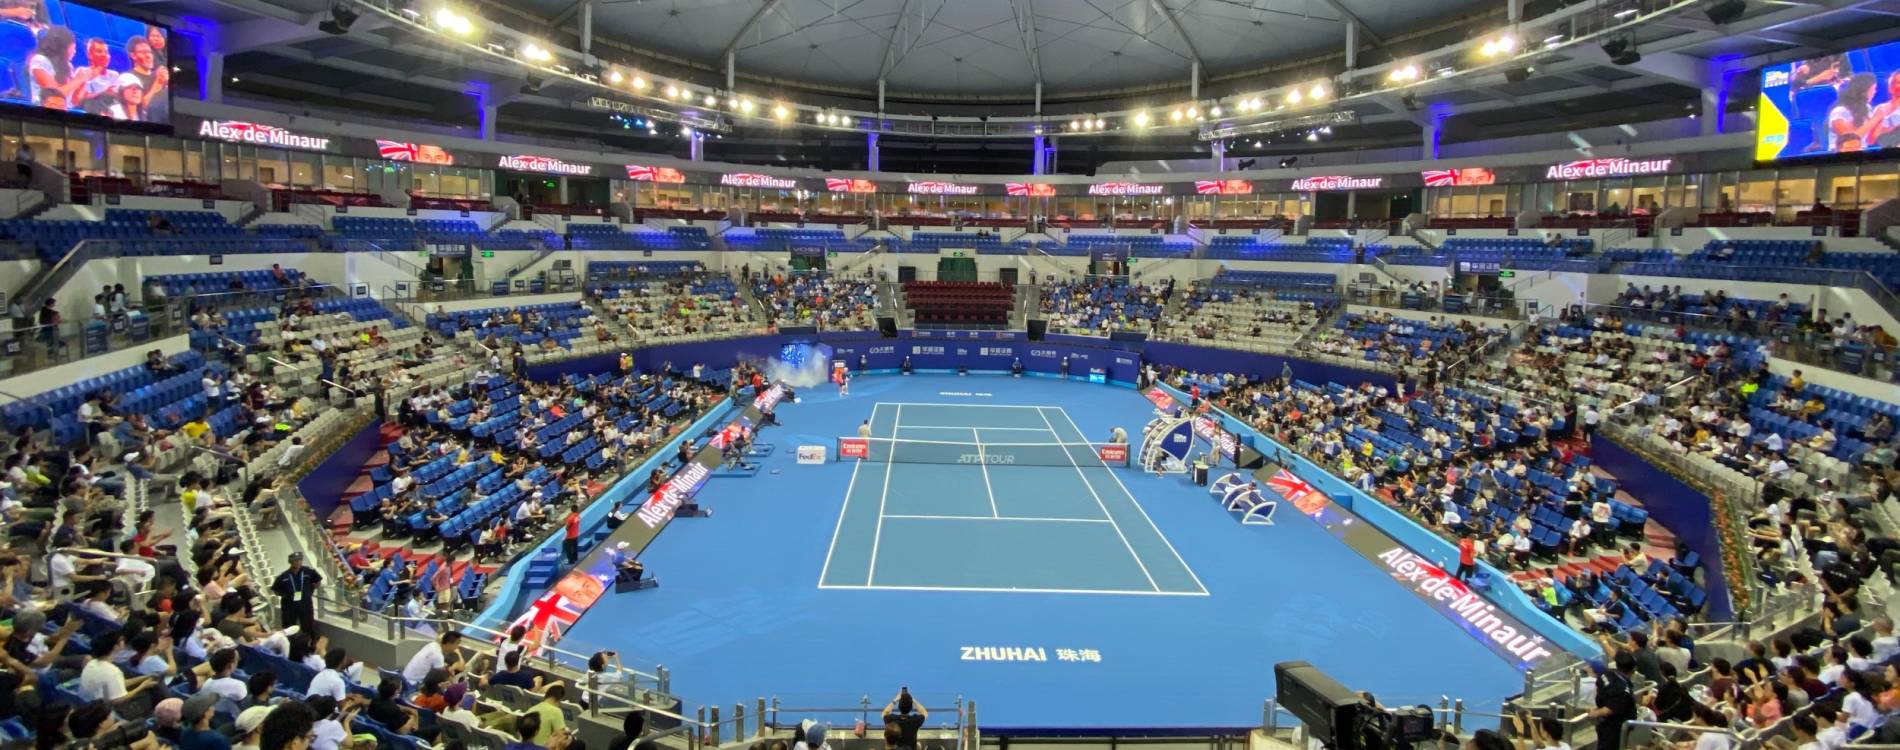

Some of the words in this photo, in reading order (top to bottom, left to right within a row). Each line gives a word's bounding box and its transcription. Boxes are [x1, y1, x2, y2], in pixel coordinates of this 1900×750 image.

[200, 120, 240, 139] Alex
[244, 126, 267, 142] de
[269, 130, 329, 149] Minaur
[499, 155, 527, 169] Alex
[529, 158, 545, 170] de
[547, 160, 592, 174] Minaur
[1546, 164, 1583, 179] Alex
[1584, 162, 1607, 176] de
[1608, 159, 1672, 174] Minaur
[721, 174, 744, 186] Alex
[746, 176, 760, 187] de
[760, 177, 797, 188] Minaur
[908, 183, 929, 193] Alex
[930, 183, 944, 193] de
[944, 183, 977, 194] Minaur
[1089, 184, 1112, 195] Alex
[1112, 183, 1126, 194] de
[1126, 183, 1164, 194] Minaur
[1291, 179, 1318, 190] Alex
[1319, 178, 1337, 189] de
[1337, 177, 1382, 188] Minaur
[984, 454, 1015, 464] TOUR
[637, 501, 673, 529] Alex
[669, 462, 709, 493] Minaur
[1378, 547, 1427, 583] Alex
[1420, 576, 1454, 601] de
[1449, 594, 1552, 662] Minaur
[960, 646, 1048, 661] ZHUHAI
[1056, 648, 1102, 662] 珠海
